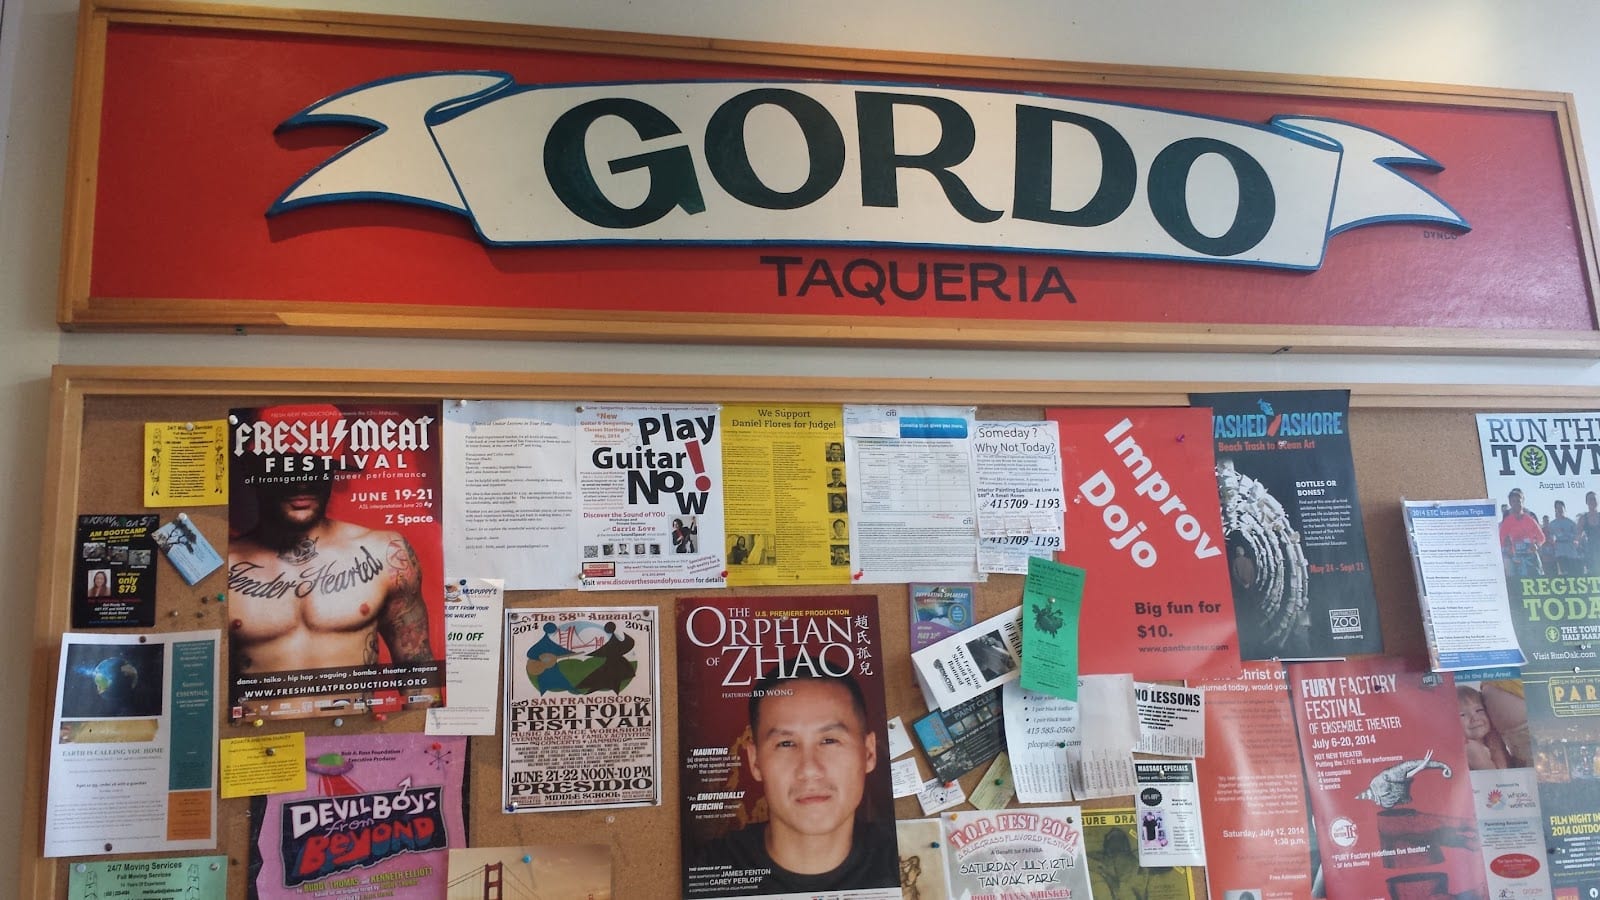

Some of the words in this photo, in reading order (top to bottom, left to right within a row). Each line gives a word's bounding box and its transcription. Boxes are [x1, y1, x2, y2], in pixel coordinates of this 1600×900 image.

[543, 88, 1276, 256] GORDO
[759, 255, 1077, 304] TAQUERIA
[758, 409, 772, 418] We
[775, 409, 811, 420] Support
[886, 409, 897, 417] citi
[638, 413, 716, 445] Play
[732, 419, 762, 428] Daniel
[764, 419, 791, 428] Flores
[794, 420, 806, 429] for
[808, 420, 836, 430] Judge!
[1212, 414, 1267, 438] ASHED
[1280, 411, 1343, 436] ASHORE
[1486, 418, 1547, 443] RUN
[1553, 418, 1600, 443] TH
[234, 418, 331, 457] FRESH
[349, 415, 435, 452] MEAT
[978, 427, 1030, 440] Someday
[975, 443, 998, 453] Why
[1000, 443, 1018, 452] Not
[1021, 442, 1055, 454] Today?
[1218, 441, 1243, 451] Beach
[1244, 440, 1265, 450] Trash
[1267, 441, 1275, 449] to
[1304, 440, 1315, 449] Art
[265, 454, 407, 473] FESTIVAL
[592, 445, 687, 469] Guitar
[244, 475, 255, 484] of
[259, 474, 318, 483] transgender
[366, 471, 427, 480] performance
[1104, 417, 1222, 560] Improv
[1539, 481, 1565, 490] August
[351, 492, 388, 502] JUNE
[394, 489, 433, 500] 19-21
[385, 514, 393, 524] Z
[397, 514, 433, 526] Space
[963, 516, 974, 525] citi
[1078, 469, 1157, 569] Dojo
[104, 528, 147, 536] BOOTCAMP
[228, 561, 298, 599] Tender
[295, 545, 383, 598] Hearted
[1310, 564, 1324, 574] May
[118, 576, 138, 585] only
[118, 585, 137, 594] $79
[728, 607, 750, 617] THE
[770, 609, 804, 617] PREMIERE
[1134, 602, 1162, 617] Big
[1167, 601, 1193, 614] fun
[1198, 601, 1221, 614] for
[532, 613, 555, 622] The
[588, 612, 632, 621] Annual
[1333, 617, 1359, 628] ZOO
[513, 622, 539, 635] 2014
[625, 621, 650, 632] 2014
[686, 606, 853, 647] ORPHAN
[1137, 625, 1173, 639] $10.
[448, 632, 463, 641] $10
[466, 632, 484, 640] OFF
[1532, 652, 1549, 660] Visit
[706, 657, 720, 667] OF
[721, 643, 855, 686] ZHAO
[952, 654, 967, 676] Should
[237, 677, 258, 685] dance
[263, 675, 282, 683] taiko
[319, 671, 347, 680] voguing
[353, 669, 377, 677] bomba
[382, 667, 407, 675] theater
[412, 665, 438, 673] trapeze
[948, 661, 964, 686] Banned
[1273, 670, 1286, 680] or
[245, 678, 428, 698] WWW.FRESHMEATPRODUCTIONS.ORG
[1252, 683, 1273, 691] would
[1301, 677, 1336, 698] FURY
[1340, 674, 1398, 696] FACTORY
[531, 698, 557, 706] SAN
[560, 695, 632, 705] FRANCISCO
[1151, 690, 1200, 706] LESSONS
[511, 705, 577, 720] FREE
[584, 703, 651, 718] FOLK
[1305, 698, 1366, 720] FESTIVAL
[511, 717, 651, 731] FESTIVAL
[1309, 723, 1319, 735] OF
[1322, 719, 1364, 734] ENSEMBLE
[1366, 716, 1402, 730] THEATER
[1312, 738, 1329, 749] July
[1331, 736, 1354, 747] 6-20,
[1355, 734, 1376, 745] 2014
[1339, 750, 1363, 758] THEATER
[511, 771, 543, 783] JUNE
[546, 769, 578, 781] 21-22
[580, 767, 631, 780] NOON-10
[634, 766, 651, 777] PM
[511, 778, 652, 795] PRESIDIO
[544, 793, 581, 801] MIDDLE
[582, 792, 621, 800] SCHOOL
[697, 791, 745, 801] EMOTIONALLY
[690, 802, 724, 811] PIERCING
[290, 797, 372, 839] DEVIL
[949, 818, 996, 849] T.O.P.
[996, 813, 1039, 831] FEST
[1040, 817, 1080, 845] 2014
[1222, 829, 1258, 838] Saturday,
[1259, 828, 1274, 837] July
[1288, 827, 1304, 835] 2014
[1551, 826, 1572, 836] 2014
[107, 864, 122, 872] 24/7
[124, 863, 150, 871] Moving
[152, 862, 182, 870] Services
[744, 868, 771, 876] FENTON
[960, 861, 1018, 874] SATURDAY
[709, 878, 731, 886] CAREY
[733, 876, 763, 884] PERLOFF
[978, 876, 999, 887] TAN
[1001, 873, 1026, 885] OAK
[1027, 871, 1060, 884] PARK
